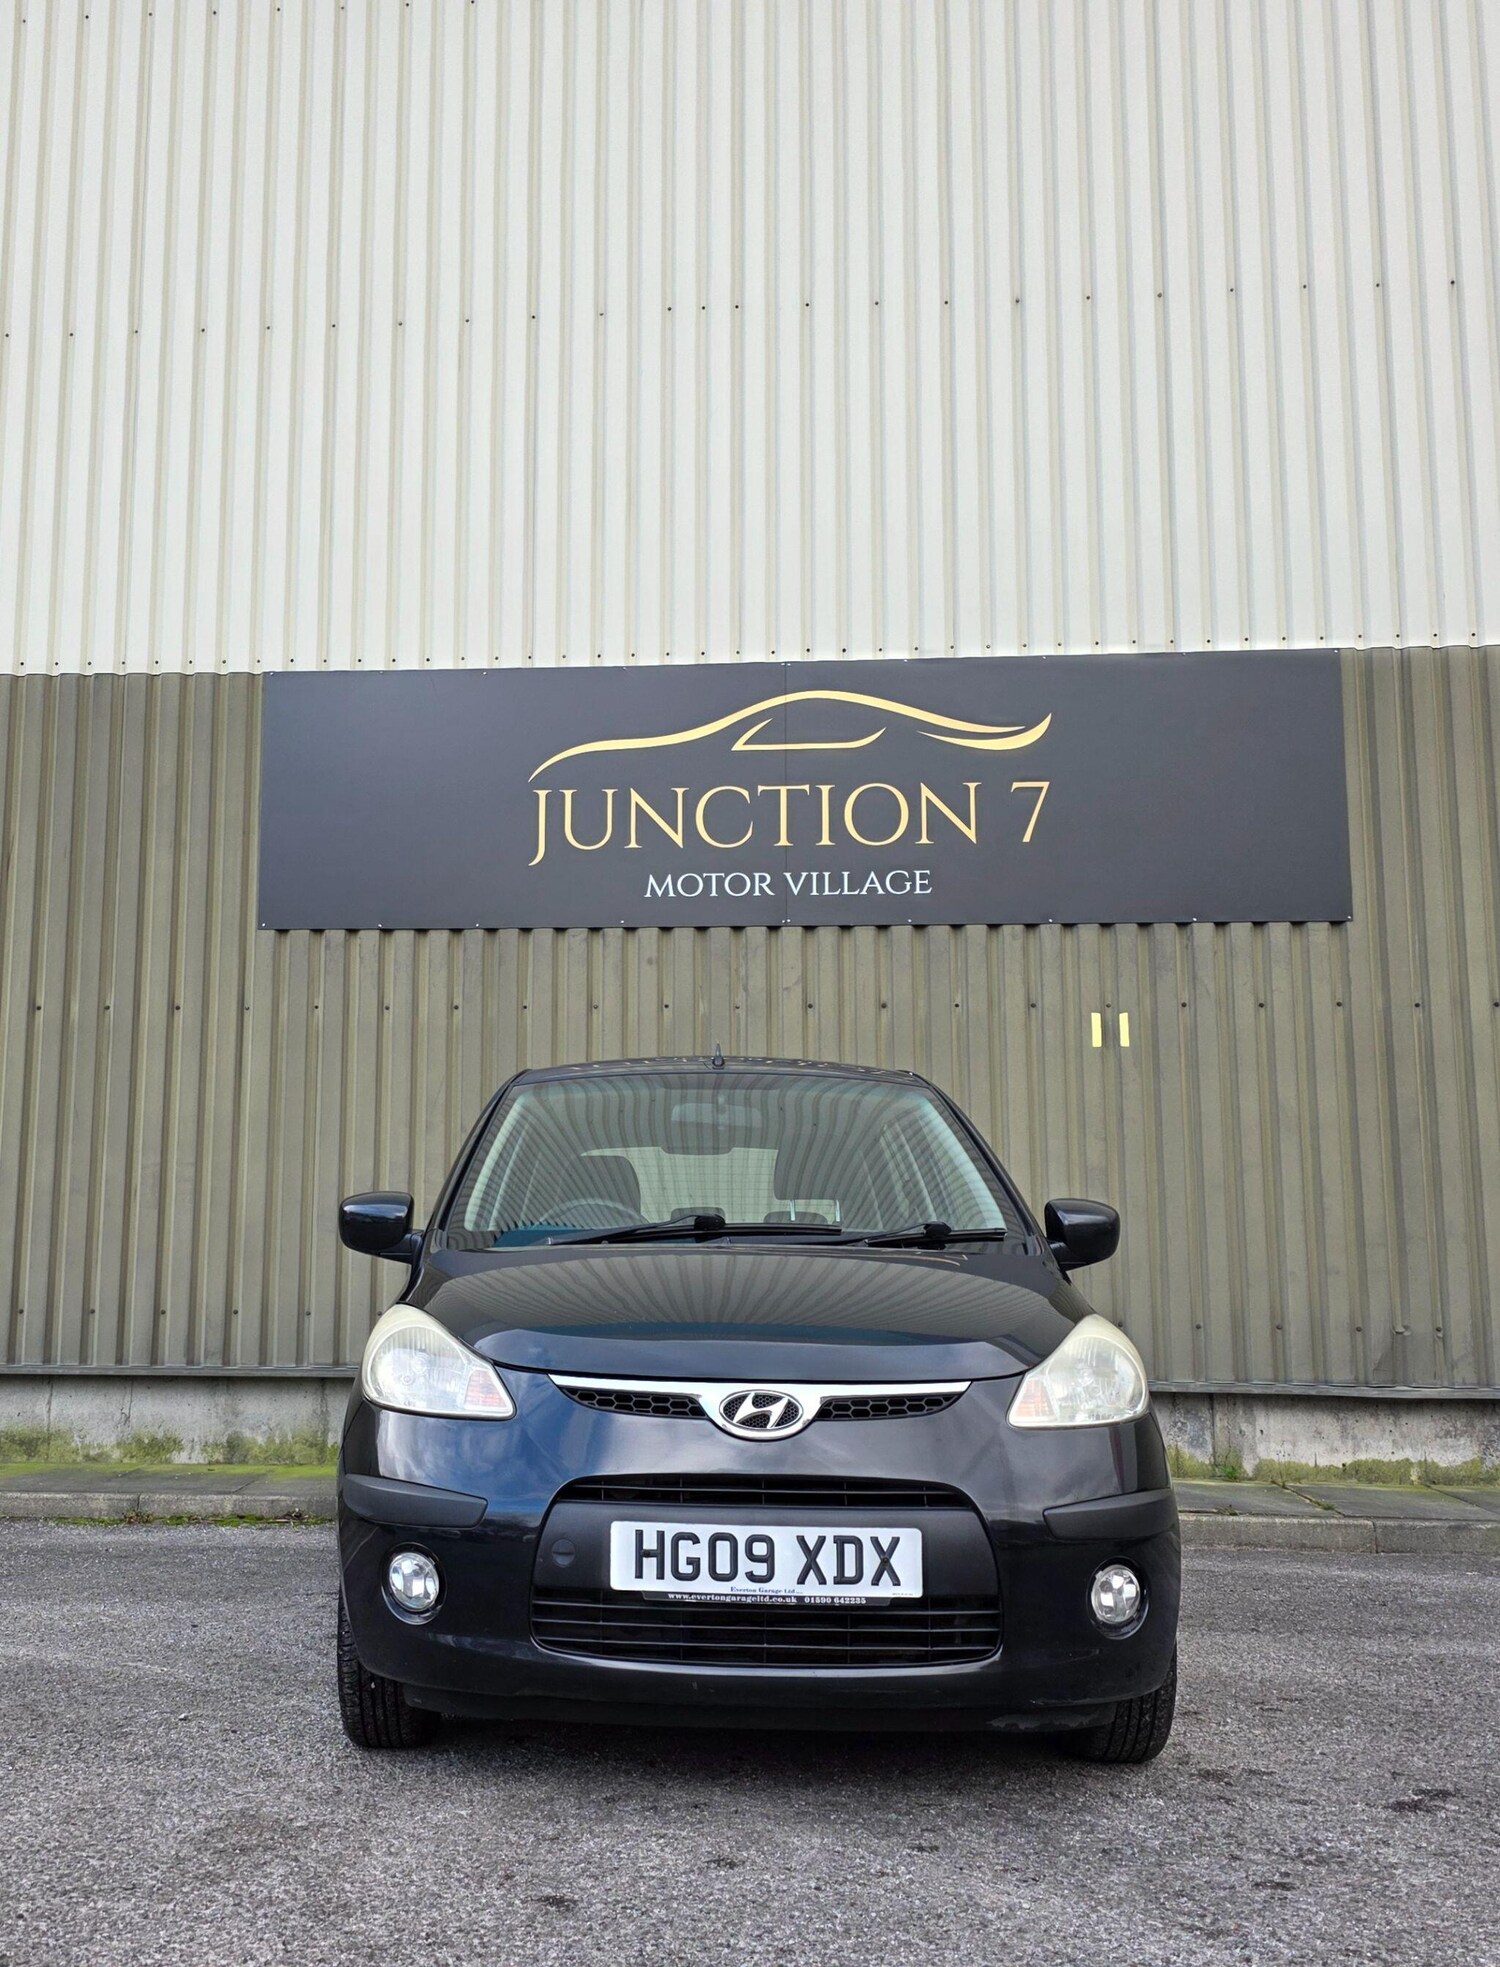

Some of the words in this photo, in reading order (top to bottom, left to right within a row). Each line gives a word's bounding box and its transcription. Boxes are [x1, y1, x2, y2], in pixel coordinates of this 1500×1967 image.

[528, 783, 982, 866] JUNCTION
[1010, 781, 1051, 843] 7
[643, 872, 776, 898] MOTOR
[783, 869, 933, 896] VILLAGE
[634, 1529, 775, 1584] HG09
[796, 1535, 901, 1587] XDX
[667, 1592, 798, 1603] www.evertongarageltd.co.uk
[804, 1596, 832, 1604] 01590
[758, 1587, 783, 1595] Garage
